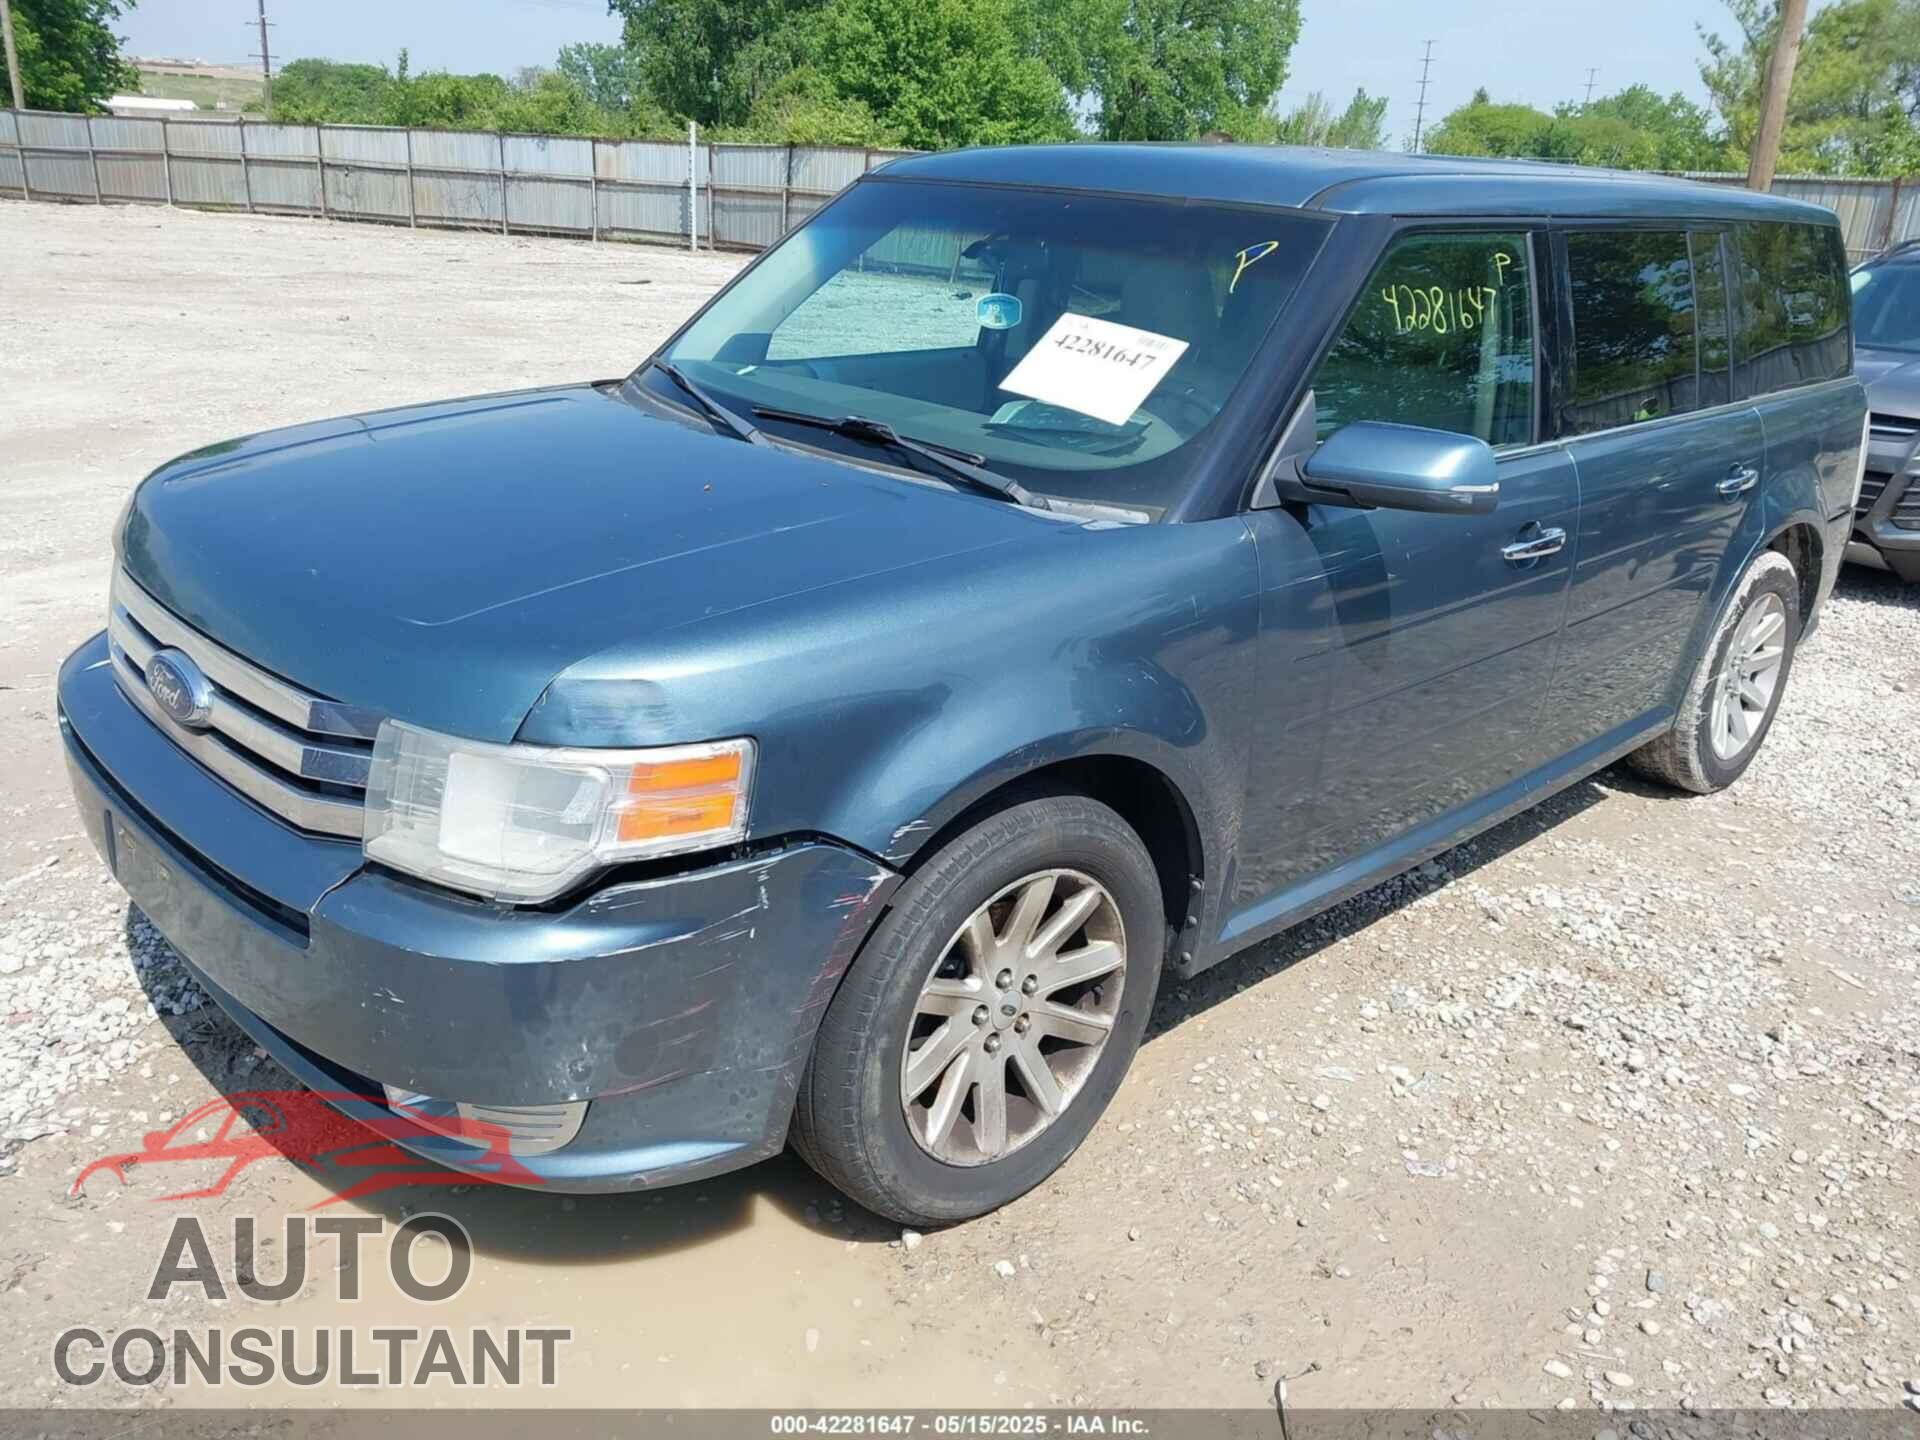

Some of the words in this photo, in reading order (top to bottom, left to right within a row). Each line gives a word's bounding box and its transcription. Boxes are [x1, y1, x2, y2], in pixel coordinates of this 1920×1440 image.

[1230, 240, 1279, 293] P
[1494, 252, 1511, 286] P
[1383, 284, 1497, 334] 42281647
[1055, 334, 1158, 371] 42281647
[151, 663, 181, 710] Ford
